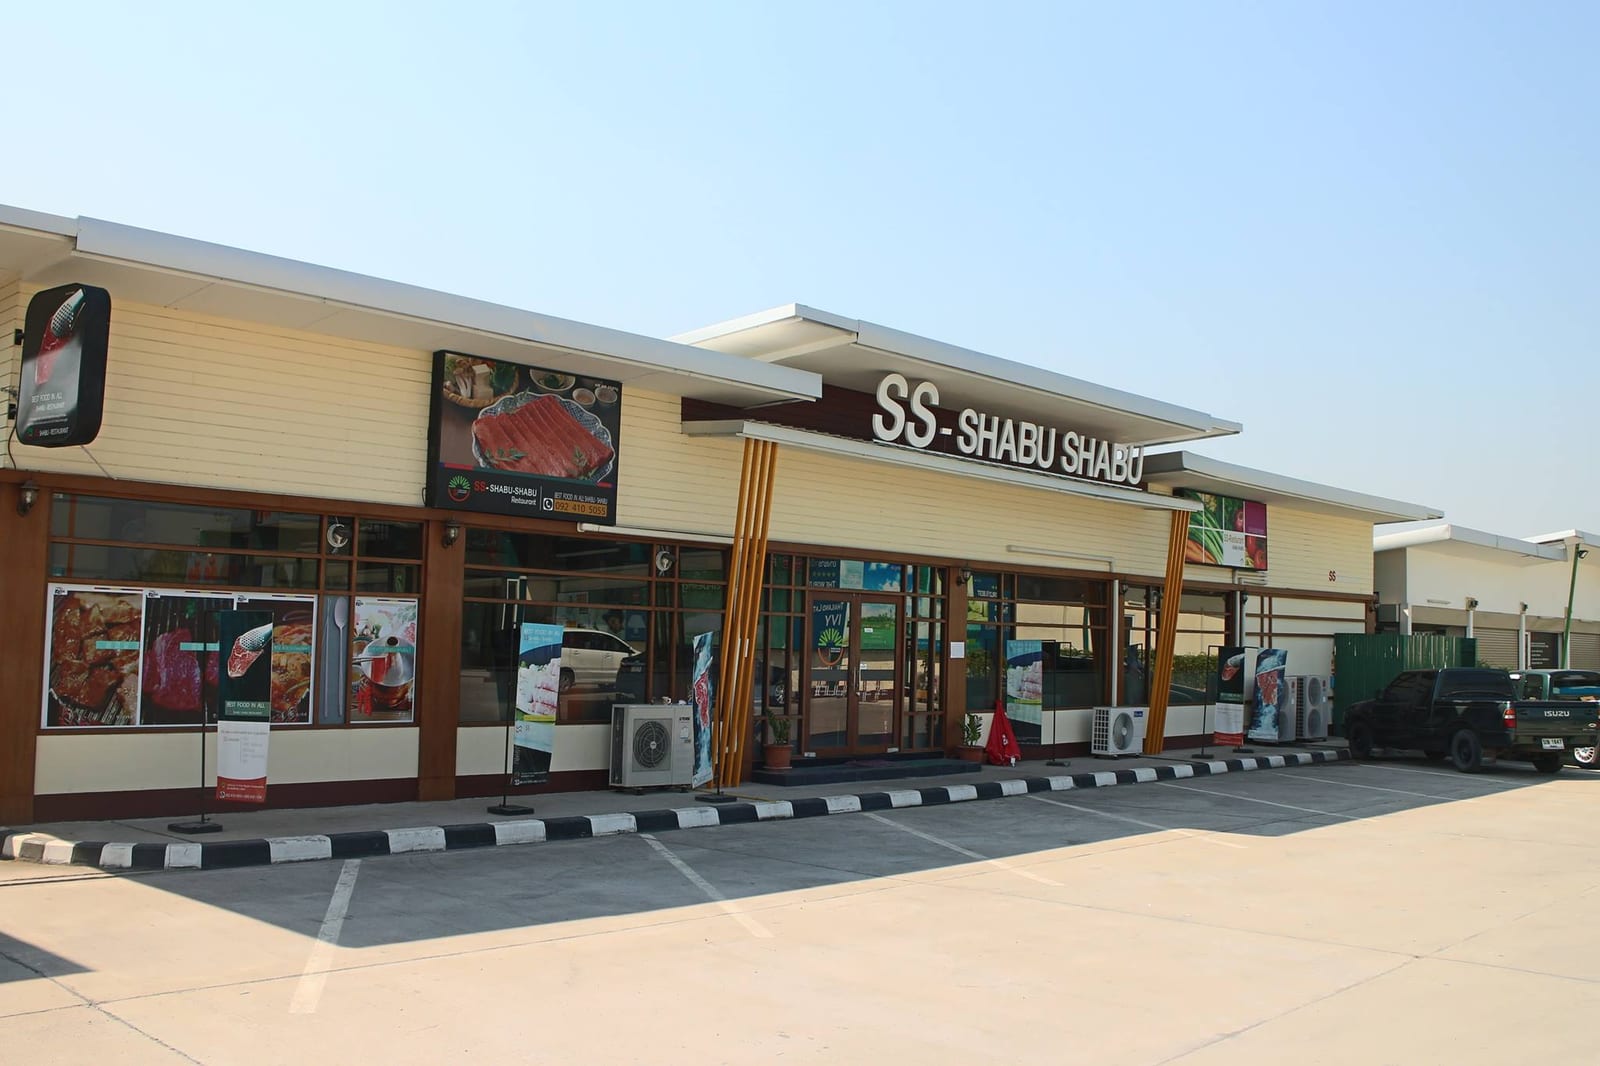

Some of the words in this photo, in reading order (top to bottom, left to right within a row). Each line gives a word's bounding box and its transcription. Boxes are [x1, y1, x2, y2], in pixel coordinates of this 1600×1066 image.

[1060, 431, 1144, 484] SHABU
[555, 501, 569, 511] 092
[572, 504, 586, 513] 410
[1328, 570, 1336, 581] SS
